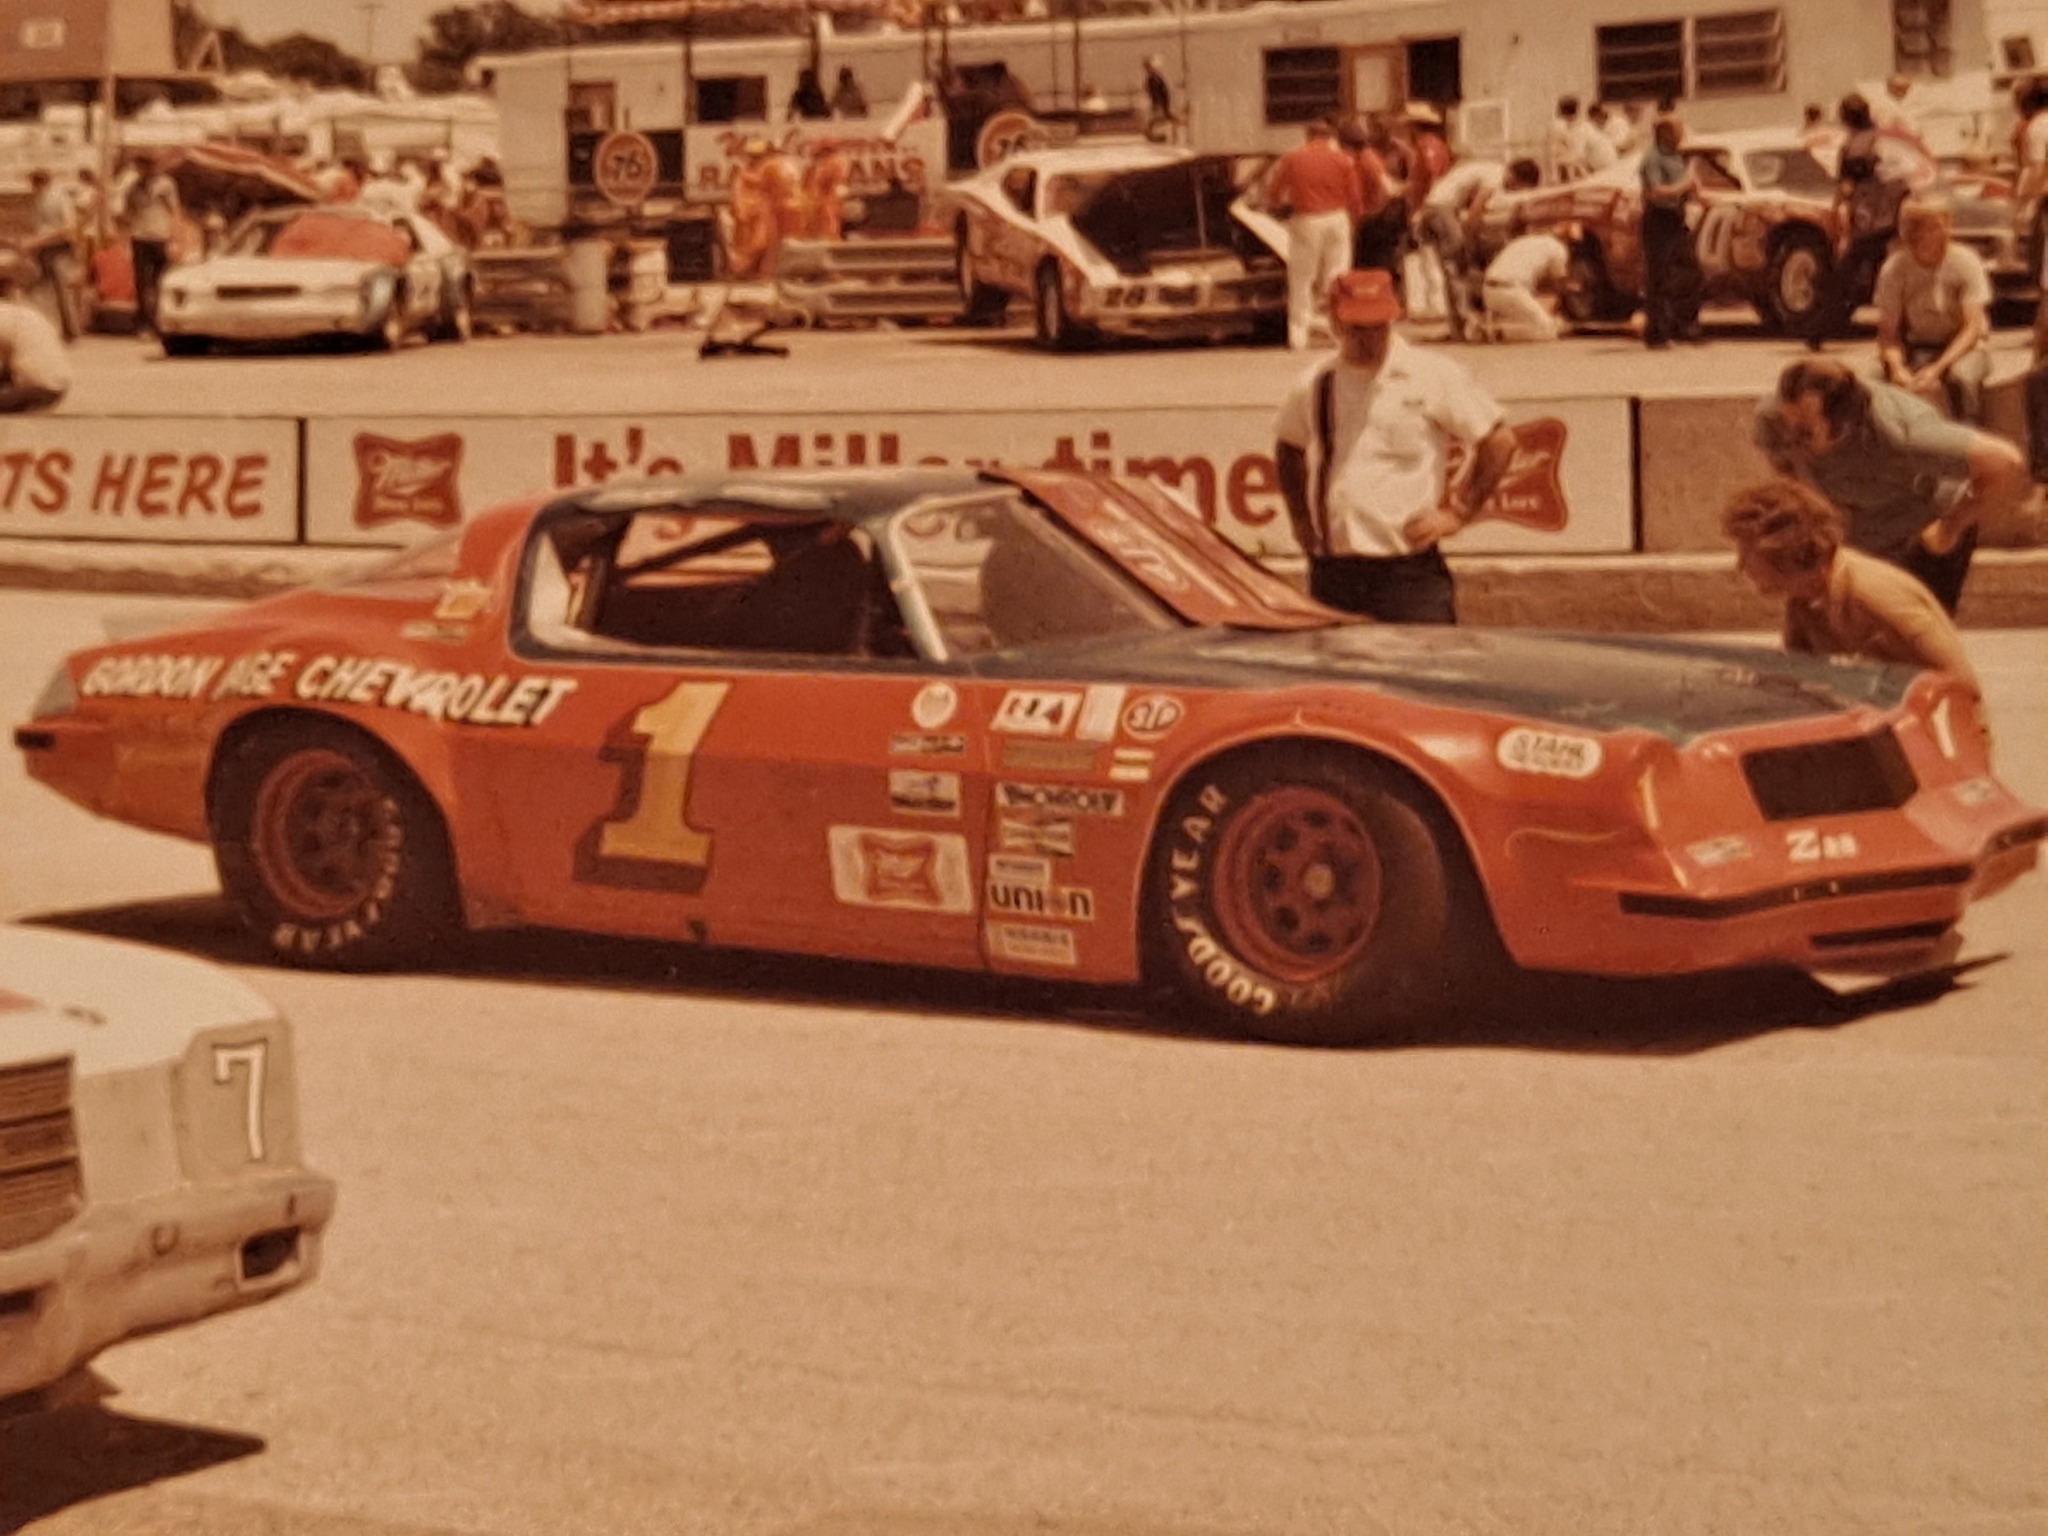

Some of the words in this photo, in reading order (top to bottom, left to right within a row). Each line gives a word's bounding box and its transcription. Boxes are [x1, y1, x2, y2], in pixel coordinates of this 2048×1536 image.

[611, 152, 643, 180] 76
[90, 450, 268, 518] HERE
[293, 654, 578, 726] CHEVROLET
[1129, 700, 1181, 731] STP
[592, 680, 732, 872] 1
[1170, 784, 1278, 1016] GOODYEAR
[211, 1038, 267, 1162] 7
